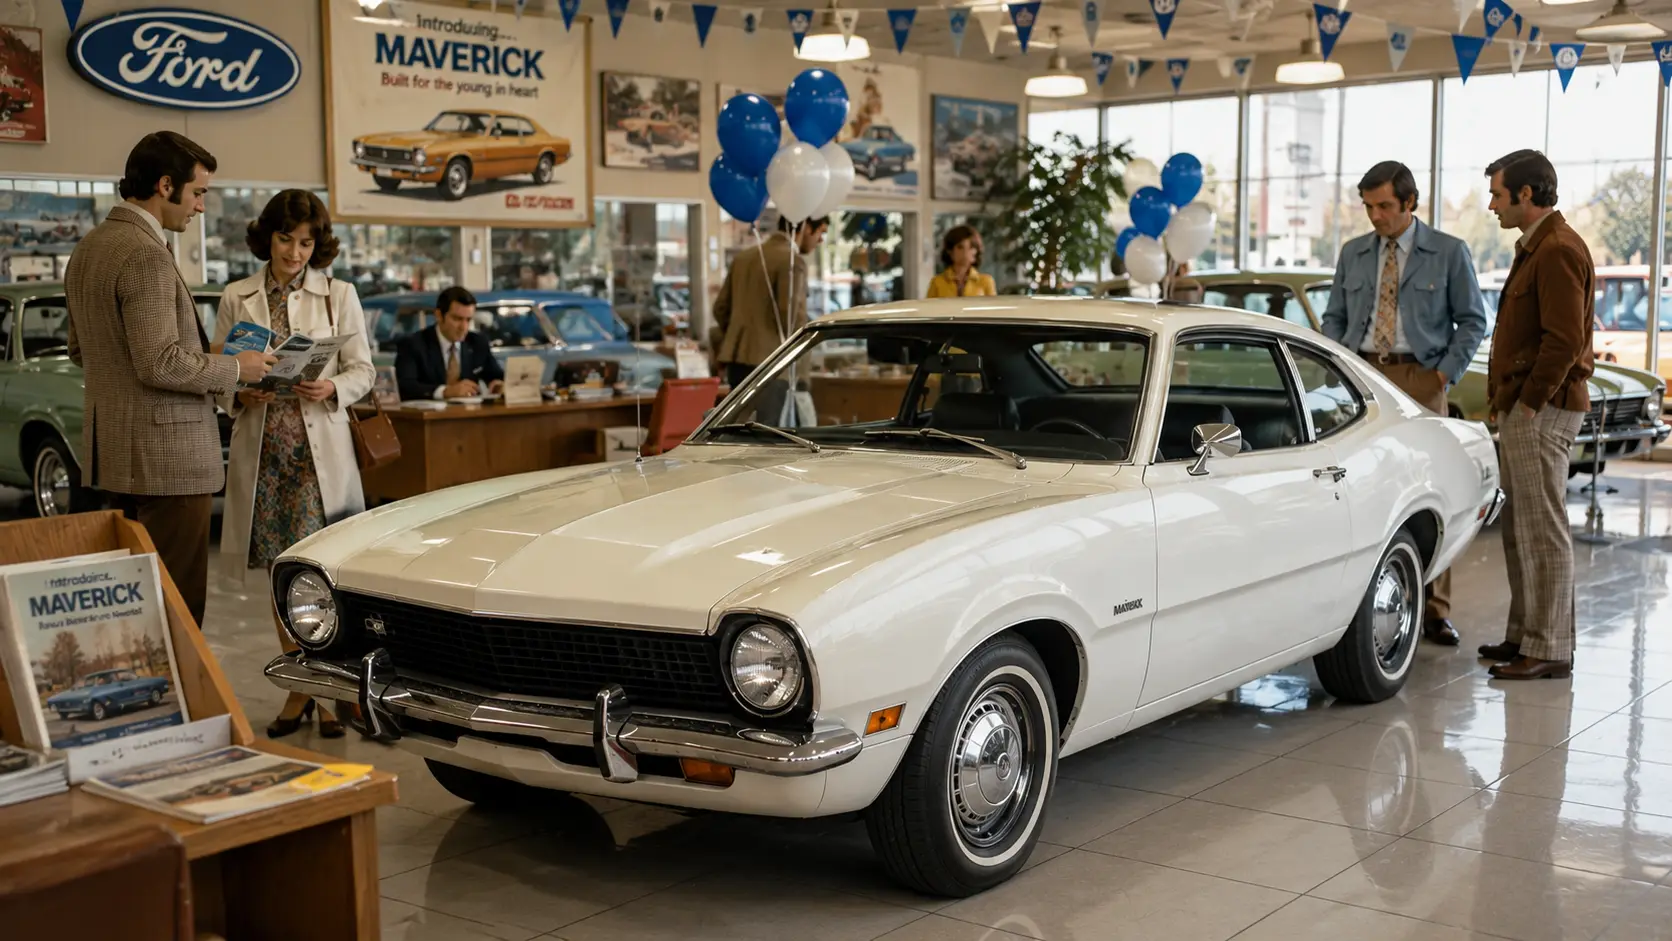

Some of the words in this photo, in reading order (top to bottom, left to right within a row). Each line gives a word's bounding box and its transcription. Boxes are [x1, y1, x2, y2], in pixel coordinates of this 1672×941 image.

[118, 21, 263, 93] Ford
[375, 32, 546, 80] MAVERICK
[380, 71, 409, 88] Built
[412, 74, 430, 90] for
[434, 76, 453, 91] the
[456, 81, 493, 98] young
[495, 81, 506, 96] in
[508, 83, 539, 98] heart
[28, 581, 145, 617] MAVERICK
